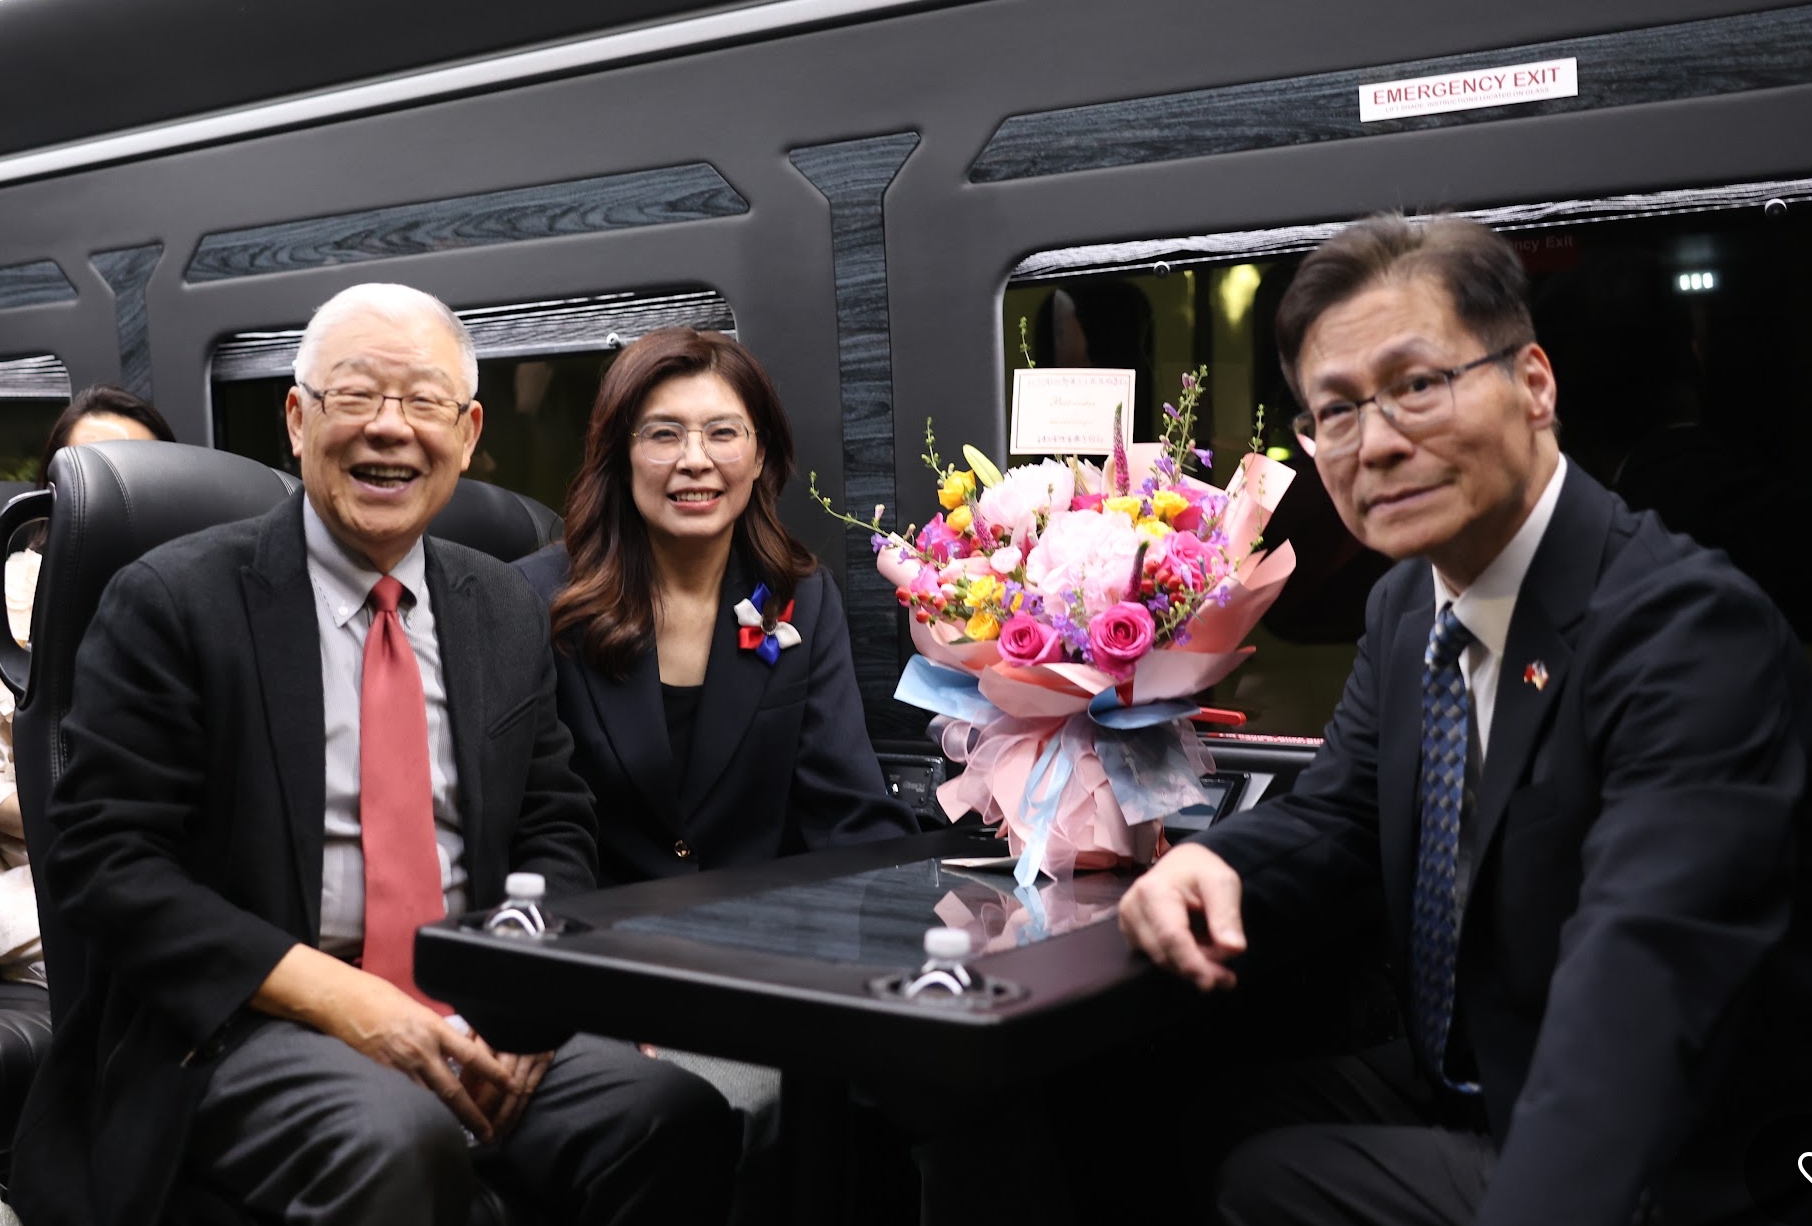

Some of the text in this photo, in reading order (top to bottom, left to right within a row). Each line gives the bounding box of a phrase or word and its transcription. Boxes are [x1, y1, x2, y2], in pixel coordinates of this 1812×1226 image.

[1373, 67, 1561, 105] EMERGENCY EXIT
[1479, 92, 1511, 102] LOCATED
[1545, 233, 1574, 249] Exit
